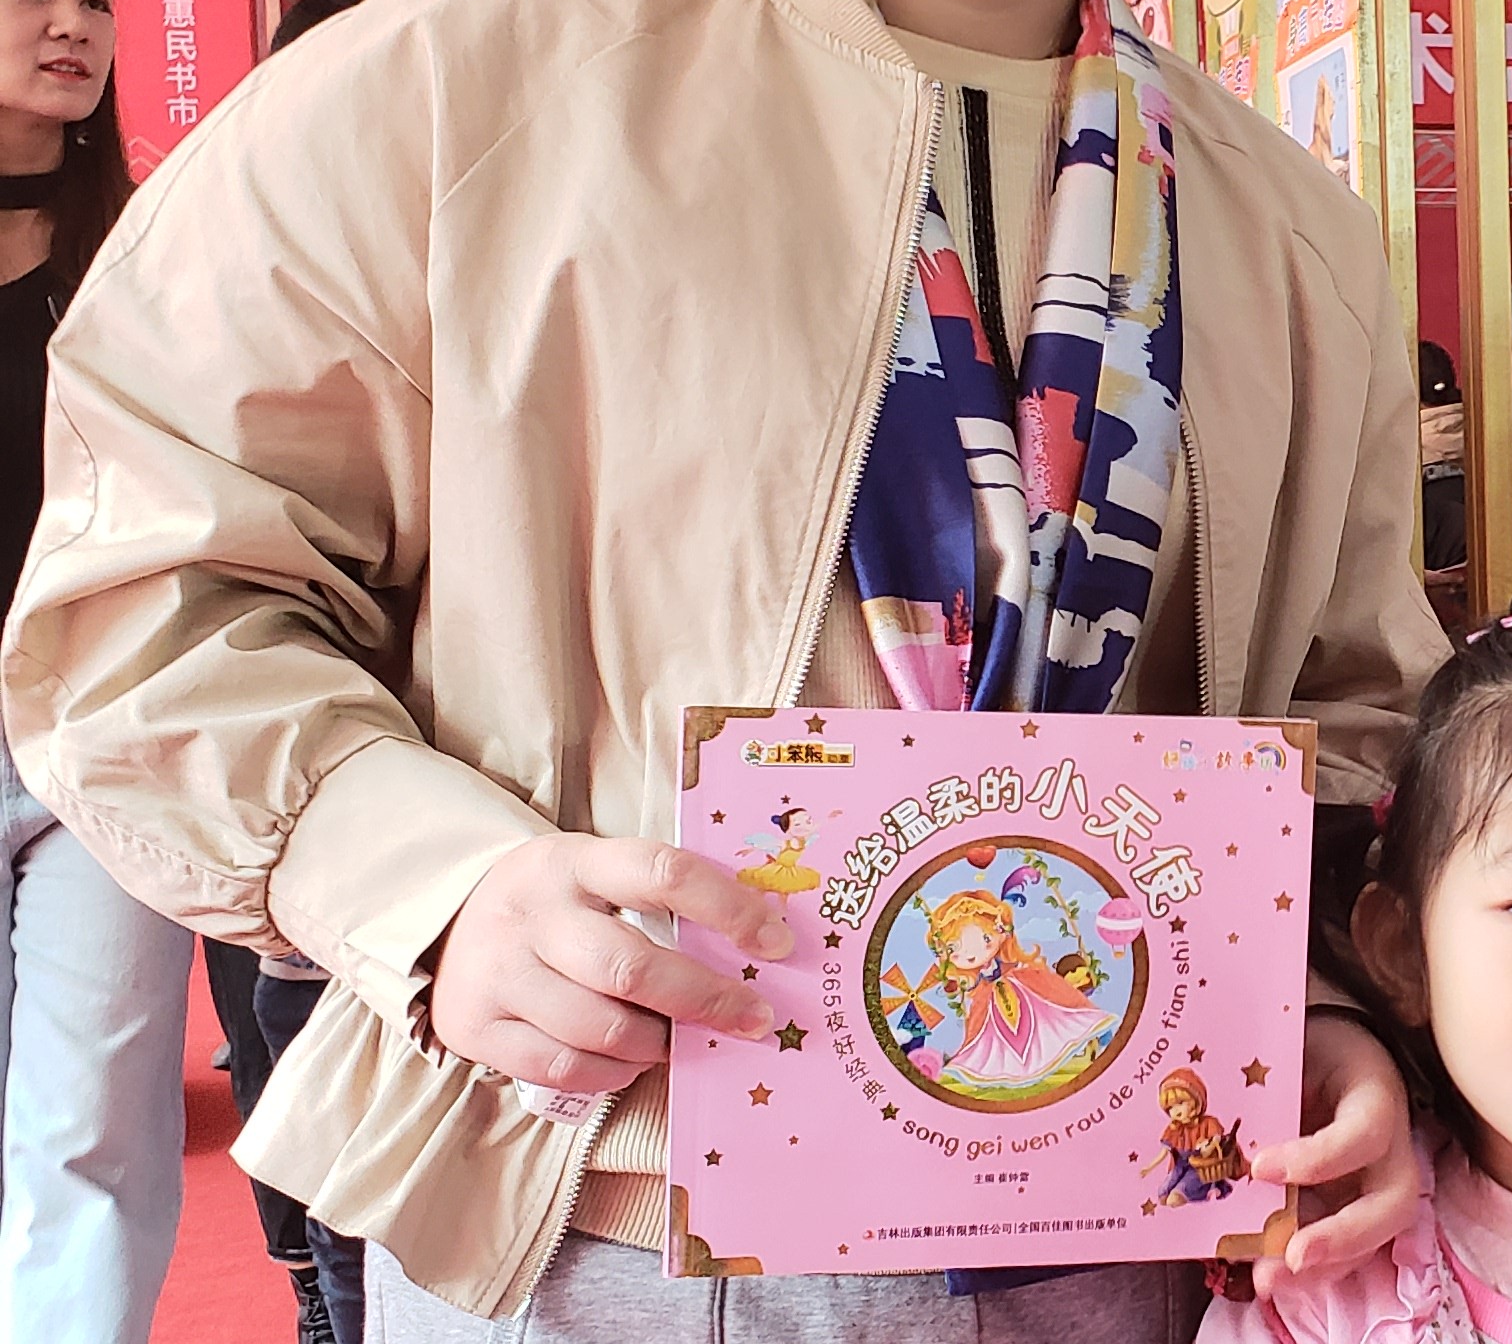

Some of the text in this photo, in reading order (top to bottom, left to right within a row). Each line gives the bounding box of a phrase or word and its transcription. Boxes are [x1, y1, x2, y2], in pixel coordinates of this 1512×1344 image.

[821, 759, 1203, 930] 送给温柔的小天使
[822, 962, 887, 1104] 365夜好经典
[902, 940, 1190, 1161] song gei wen rou de xiao tian shi
[973, 1173, 995, 1185] 主编
